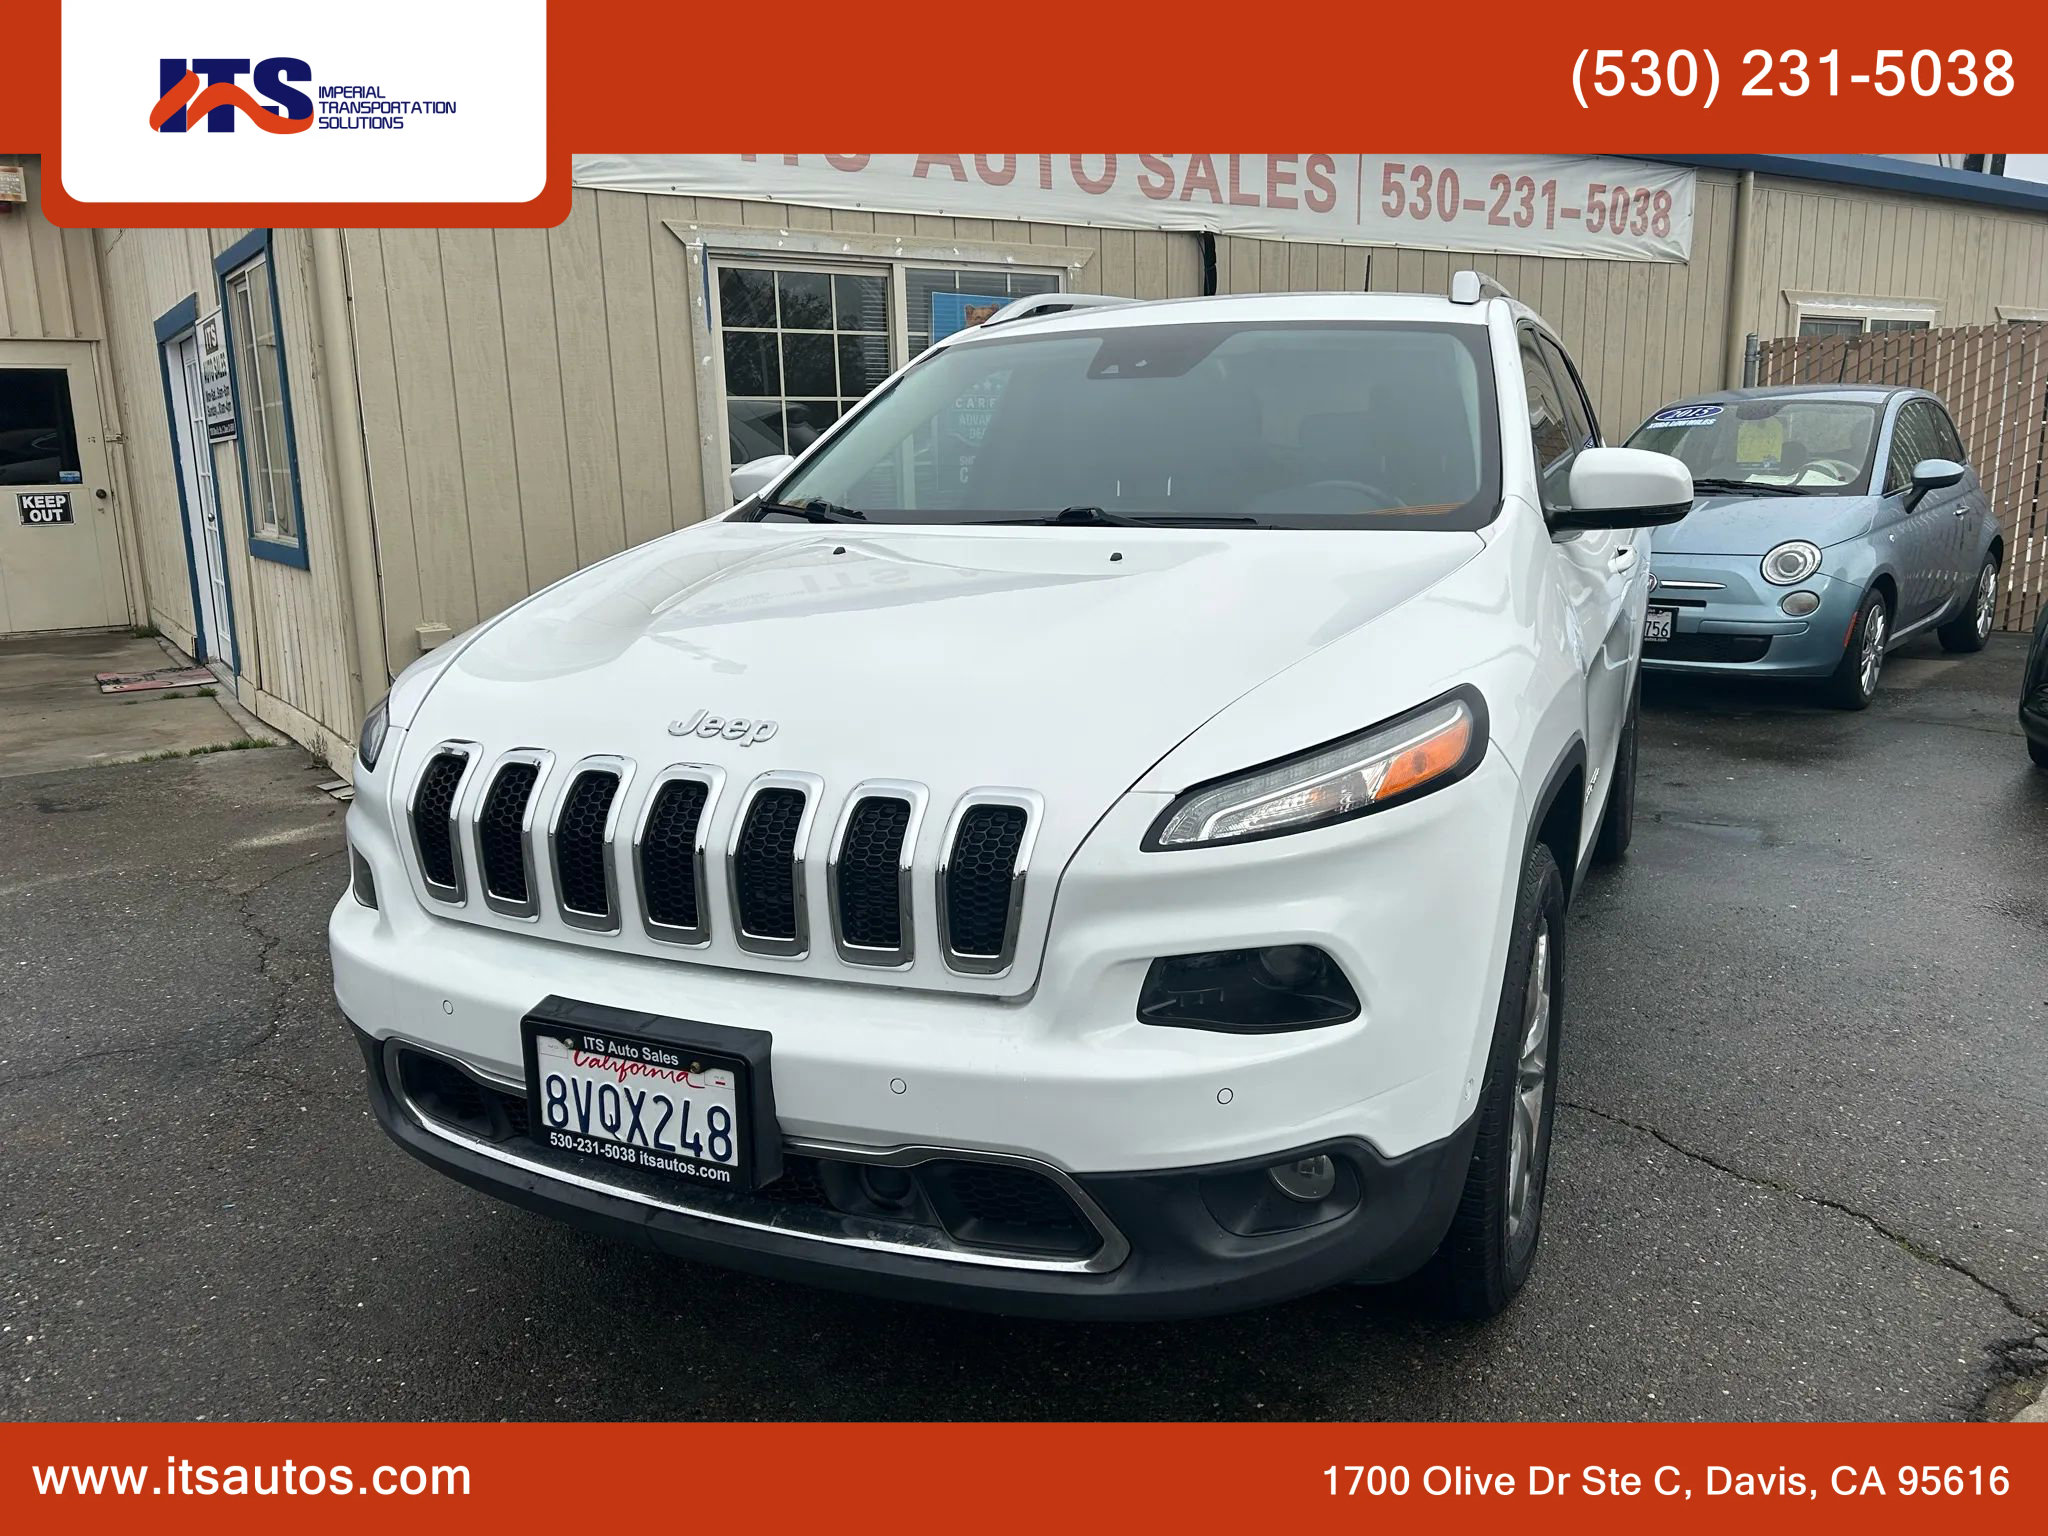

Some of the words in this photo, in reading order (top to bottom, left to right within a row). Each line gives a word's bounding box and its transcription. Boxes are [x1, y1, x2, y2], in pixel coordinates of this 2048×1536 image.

[1137, 154, 1336, 213] SALES
[1381, 162, 1673, 239] 530-231-5038
[204, 323, 217, 350] ITS
[1664, 407, 1714, 420] 2015
[21, 495, 66, 509] KEEP
[29, 508, 63, 522] OUT
[667, 708, 779, 748] Jeep
[573, 1047, 705, 1088] California
[583, 1036, 604, 1052] ITS
[608, 1041, 639, 1059] Auto
[642, 1046, 679, 1066] Sales
[545, 1074, 733, 1163] 8VQX248
[550, 1132, 636, 1164] 530-231-5038
[639, 1150, 731, 1183] itsautos.com
